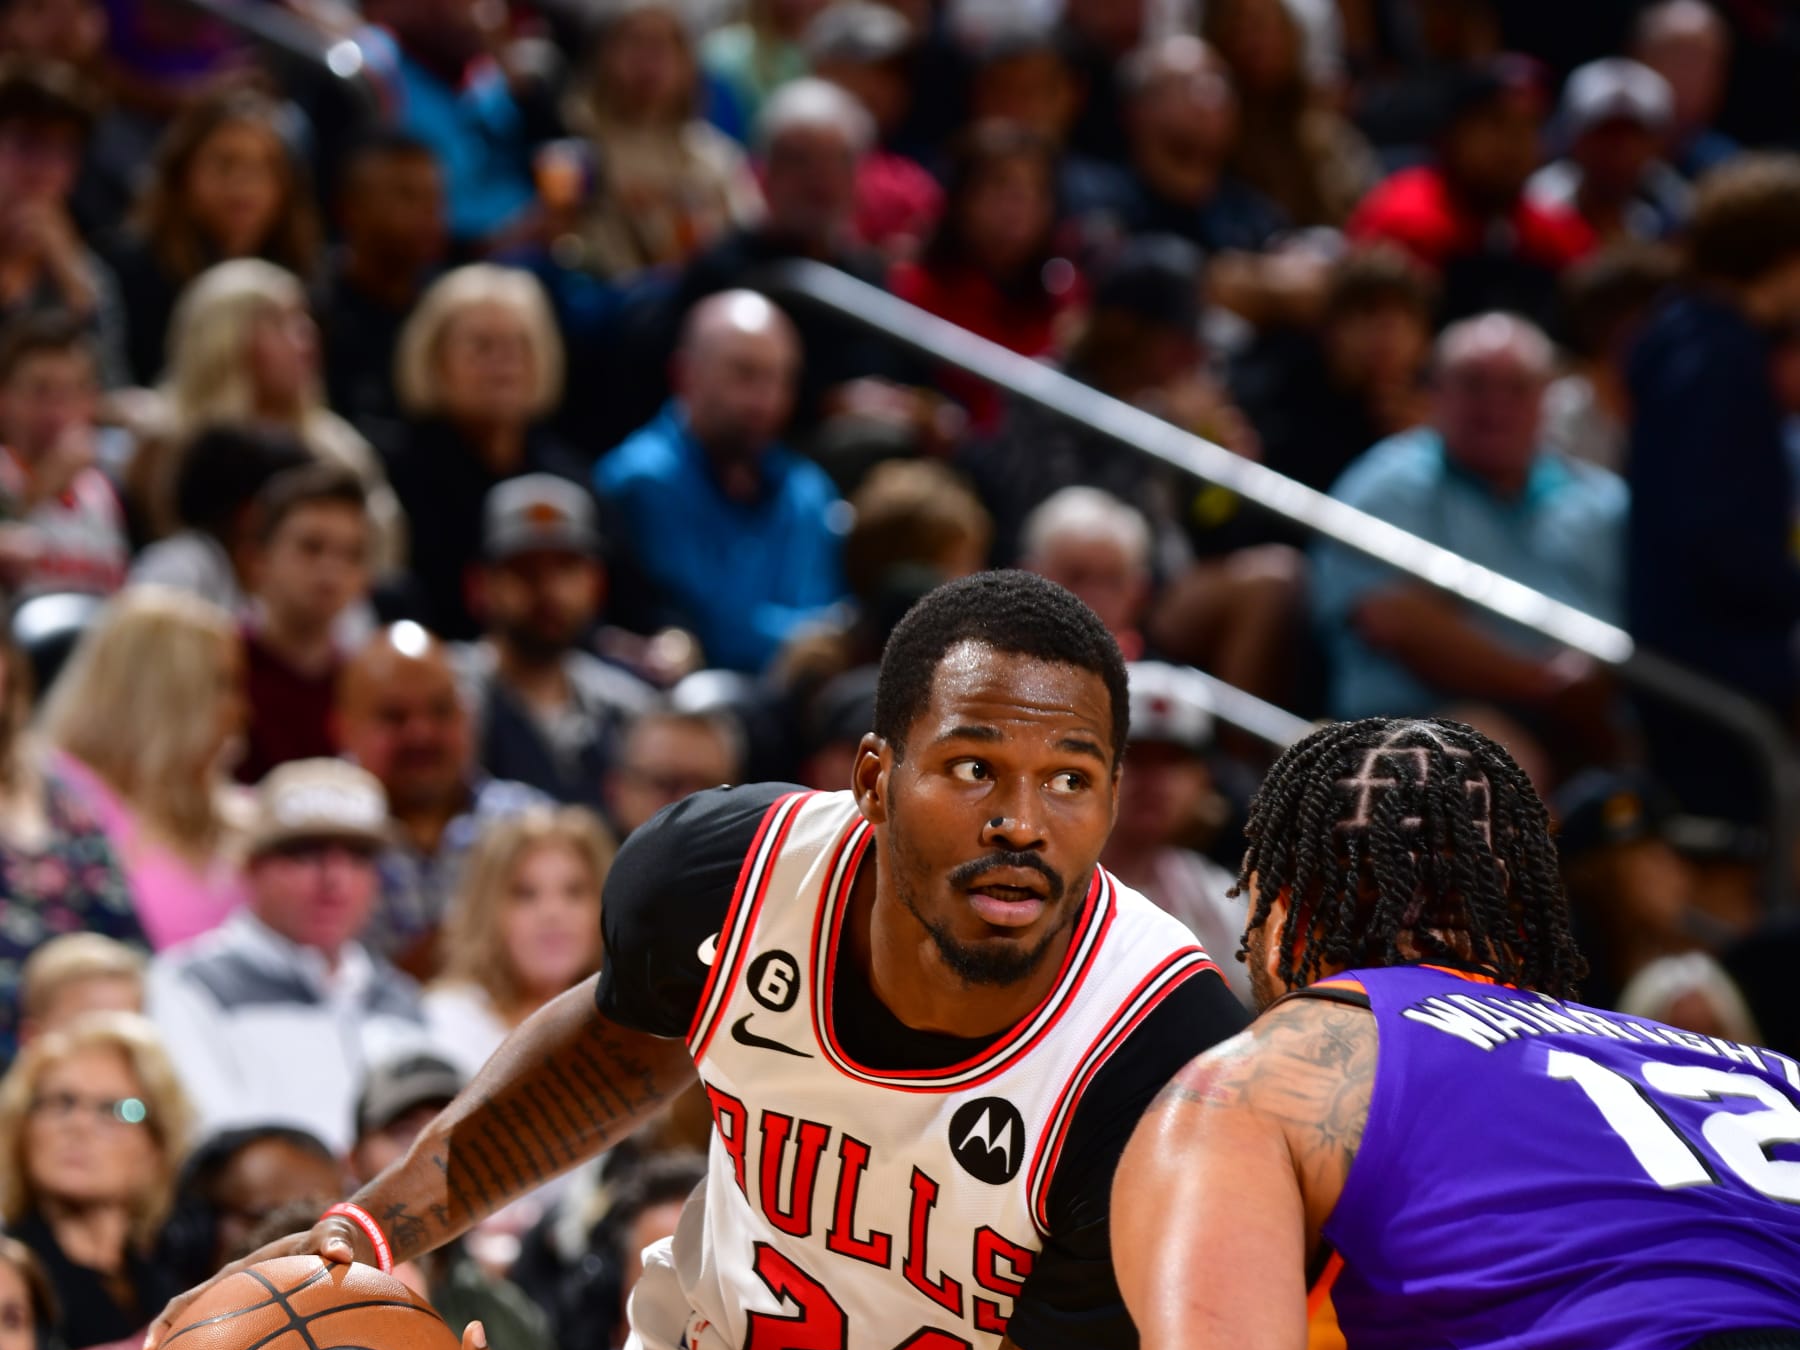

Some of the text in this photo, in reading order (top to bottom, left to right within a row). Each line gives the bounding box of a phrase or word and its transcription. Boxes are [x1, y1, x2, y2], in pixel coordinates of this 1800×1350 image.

[757, 957, 796, 1006] 6
[1547, 1048, 1800, 1203] 12
[704, 1084, 1041, 1335] BULLS
